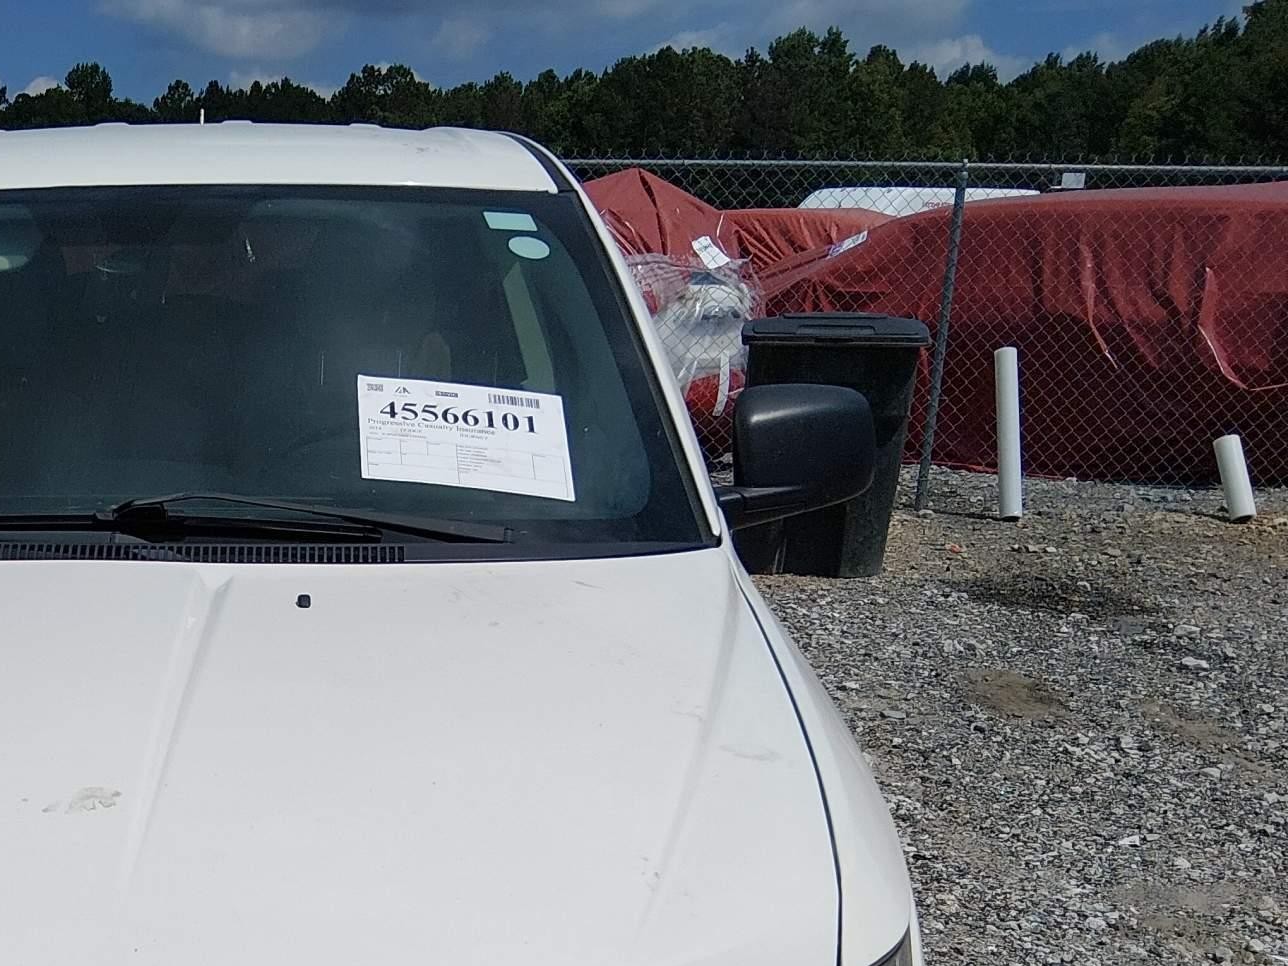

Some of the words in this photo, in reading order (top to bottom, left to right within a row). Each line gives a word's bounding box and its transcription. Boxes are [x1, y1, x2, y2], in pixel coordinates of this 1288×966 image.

[367, 417, 416, 428] Progressive
[417, 422, 453, 431] Casualty
[456, 425, 496, 436] Insurance
[379, 400, 539, 434] 45566101
